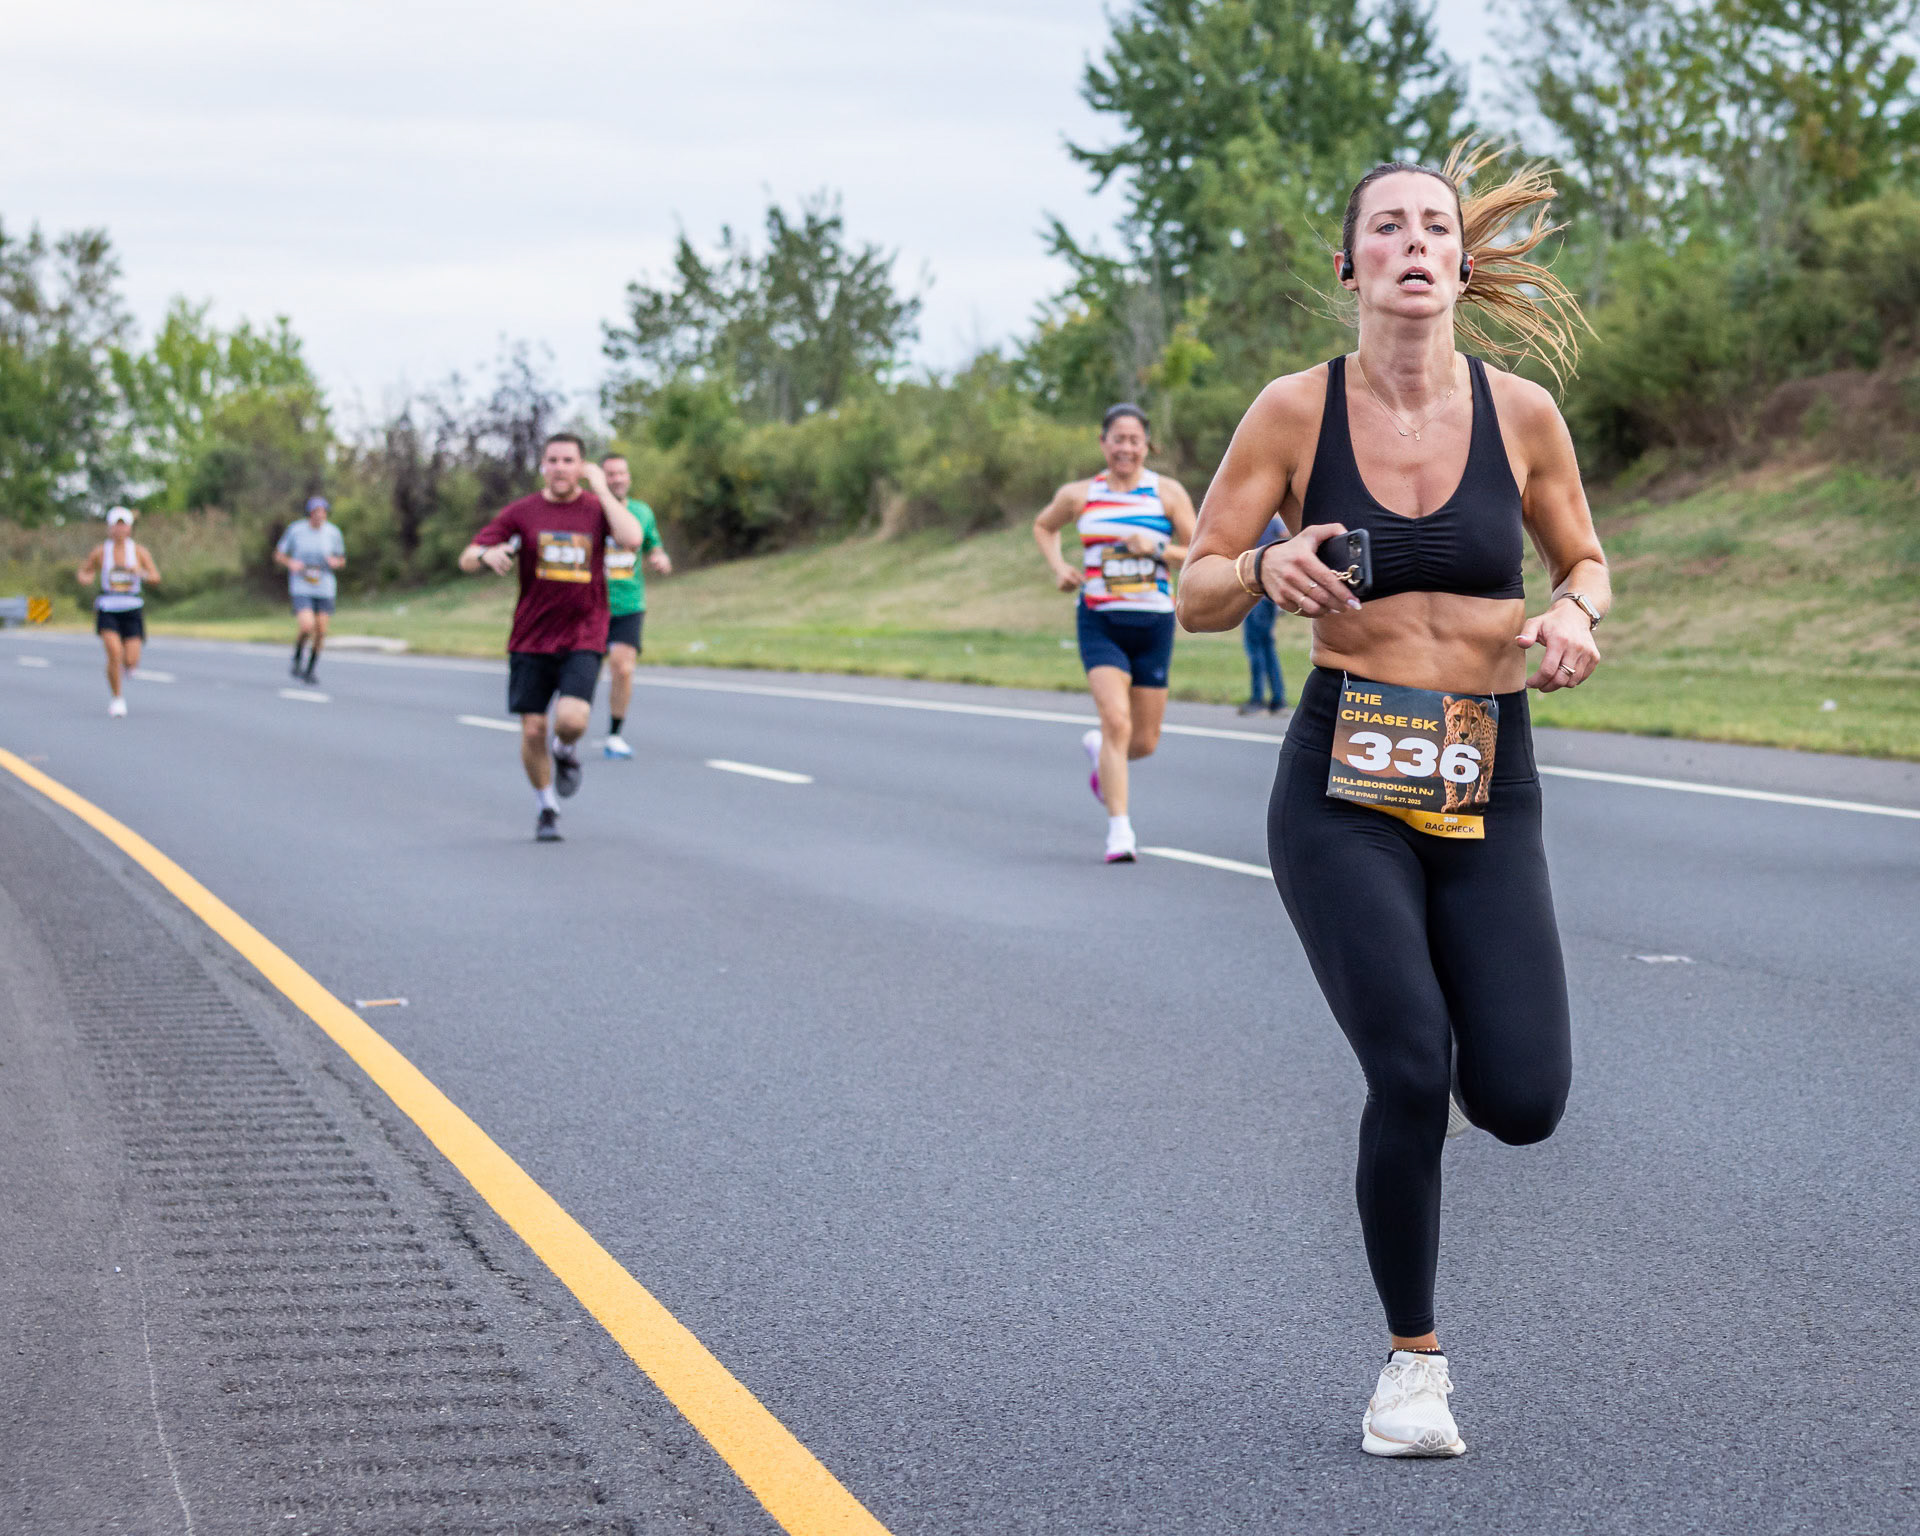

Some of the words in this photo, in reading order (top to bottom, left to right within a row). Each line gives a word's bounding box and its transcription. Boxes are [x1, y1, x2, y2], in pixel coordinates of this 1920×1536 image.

[1344, 691, 1382, 706] THE
[1341, 710, 1408, 727] CHASE
[1411, 718, 1440, 732] 5K
[1347, 731, 1482, 783] 336
[1332, 776, 1418, 794] HILLSBOROUGH,
[1418, 788, 1435, 796] NJ
[1355, 791, 1378, 799] BYPASS
[1383, 795, 1398, 803] Sept
[1424, 822, 1445, 832] BAG
[1446, 824, 1475, 833] CHECK
